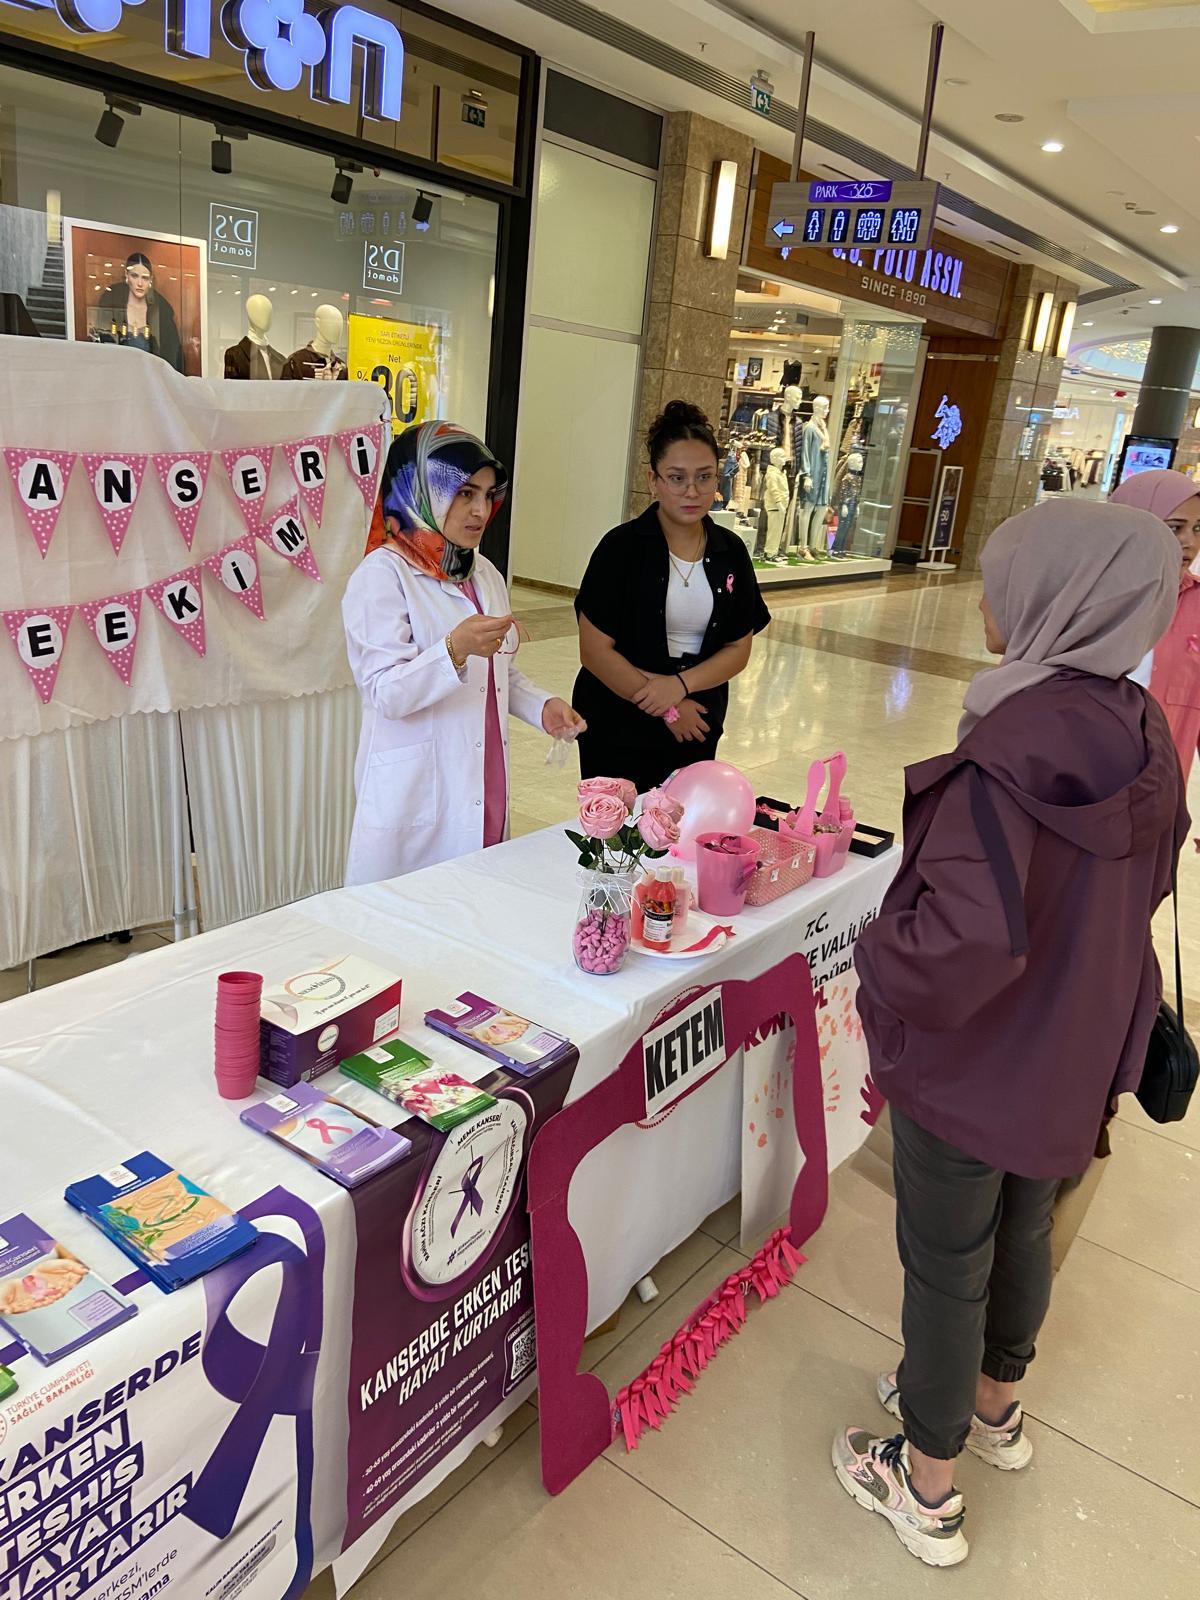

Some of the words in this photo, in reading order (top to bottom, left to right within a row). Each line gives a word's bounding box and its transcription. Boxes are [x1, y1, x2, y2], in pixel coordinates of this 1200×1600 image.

[815, 185, 839, 199] PARK
[861, 276, 897, 298] SINCE
[901, 289, 926, 306] 1890
[920, 248, 963, 299] ASSN.
[388, 354, 401, 363] Net
[804, 911, 829, 941] T.C.
[645, 996, 724, 1102] KETEM
[457, 1123, 476, 1147] MEME
[360, 1310, 450, 1412] KANSERDE
[453, 1265, 501, 1329] ERKEN
[399, 1342, 450, 1406] HAYAT
[452, 1277, 522, 1357] KURTARIR
[6, 1391, 40, 1415] TÜRKİYE
[10, 1400, 44, 1425] SAĞLIK
[45, 1368, 95, 1403] BAKANLIĞI
[366, 1476, 382, 1494] 40-69
[381, 1468, 392, 1482] yaş
[391, 1442, 417, 1471] arasındaki
[416, 1426, 436, 1448] kadınlar
[0, 1453, 139, 1574] TEŞHİS
[42, 1483, 187, 1600] RTARIR
[93, 1562, 142, 1600] erkezi,
[138, 1573, 170, 1600] ama
